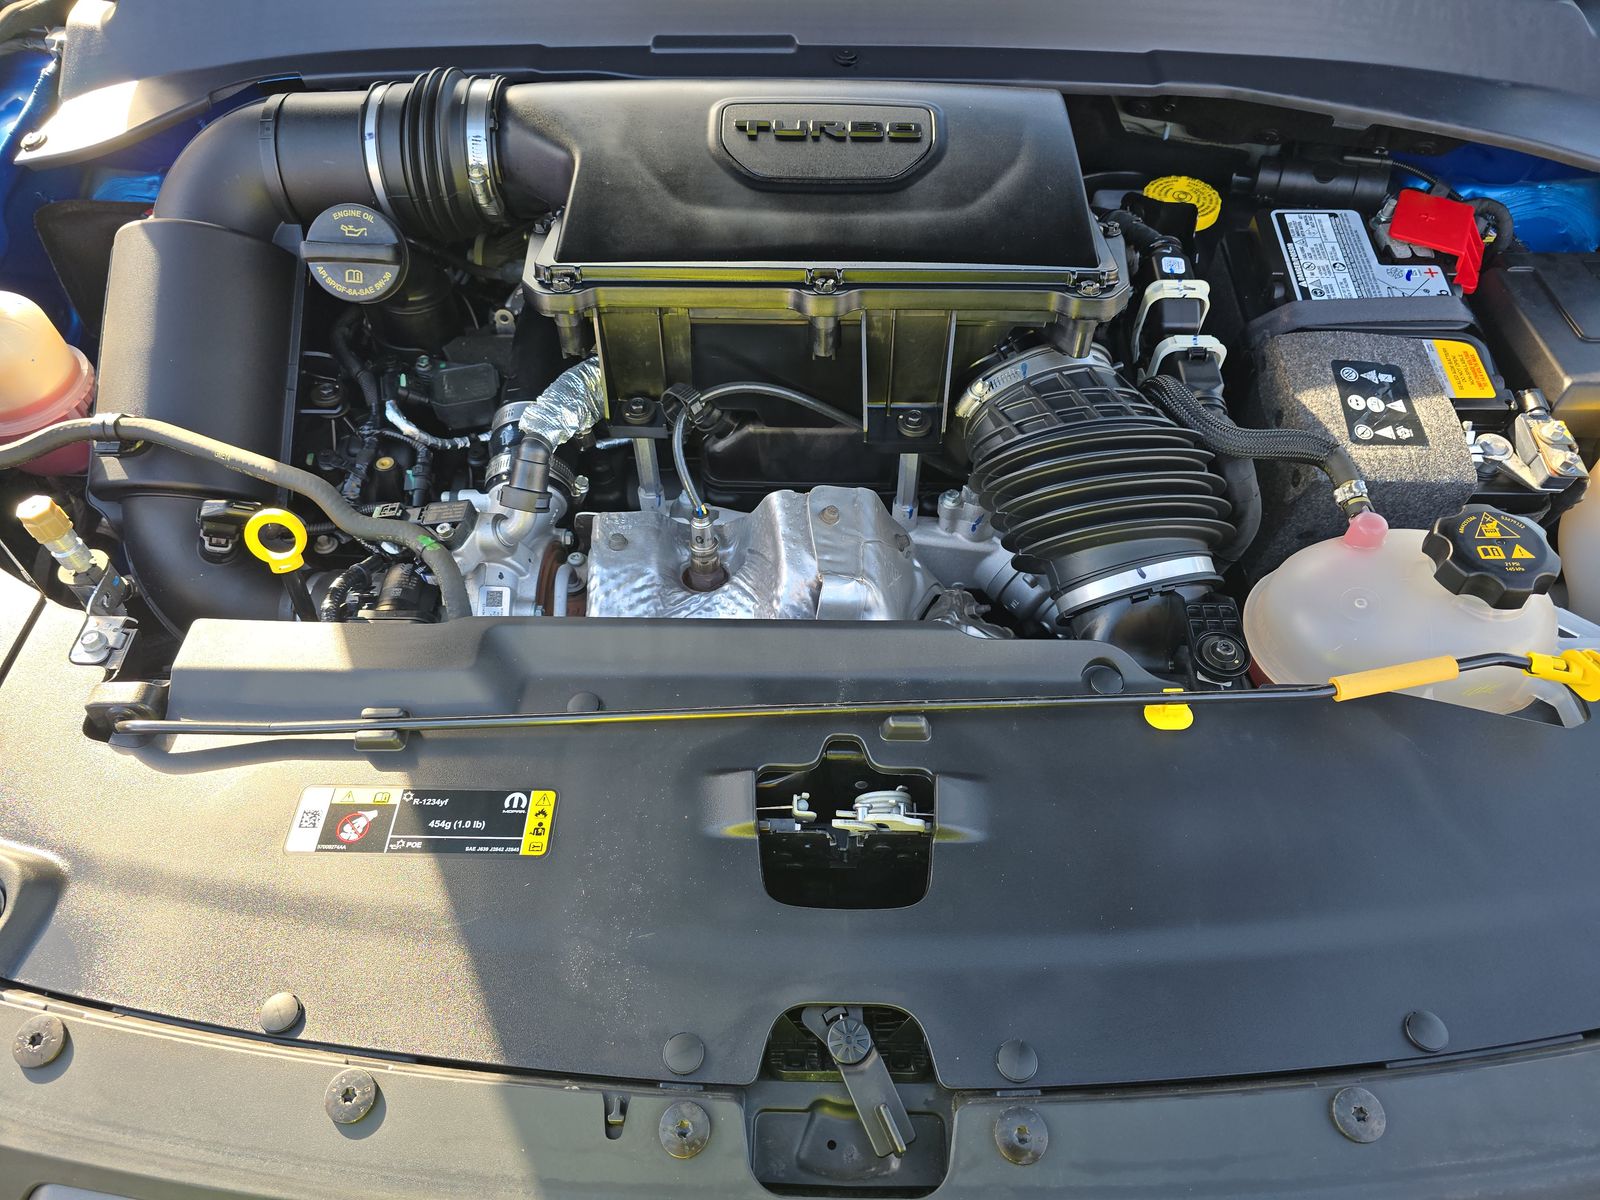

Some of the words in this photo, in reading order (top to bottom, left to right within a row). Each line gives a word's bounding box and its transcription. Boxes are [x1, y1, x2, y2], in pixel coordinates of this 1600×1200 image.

[734, 119, 923, 142] TURBO
[332, 210, 361, 220] ENGINE
[363, 212, 374, 223] OIL
[317, 266, 328, 280] API
[374, 272, 392, 289] 5W-30
[412, 798, 449, 807] R-1234yf
[428, 820, 452, 830] 454g
[453, 820, 471, 830] (1.0
[473, 820, 486, 830] lb)
[405, 841, 423, 849] POE
